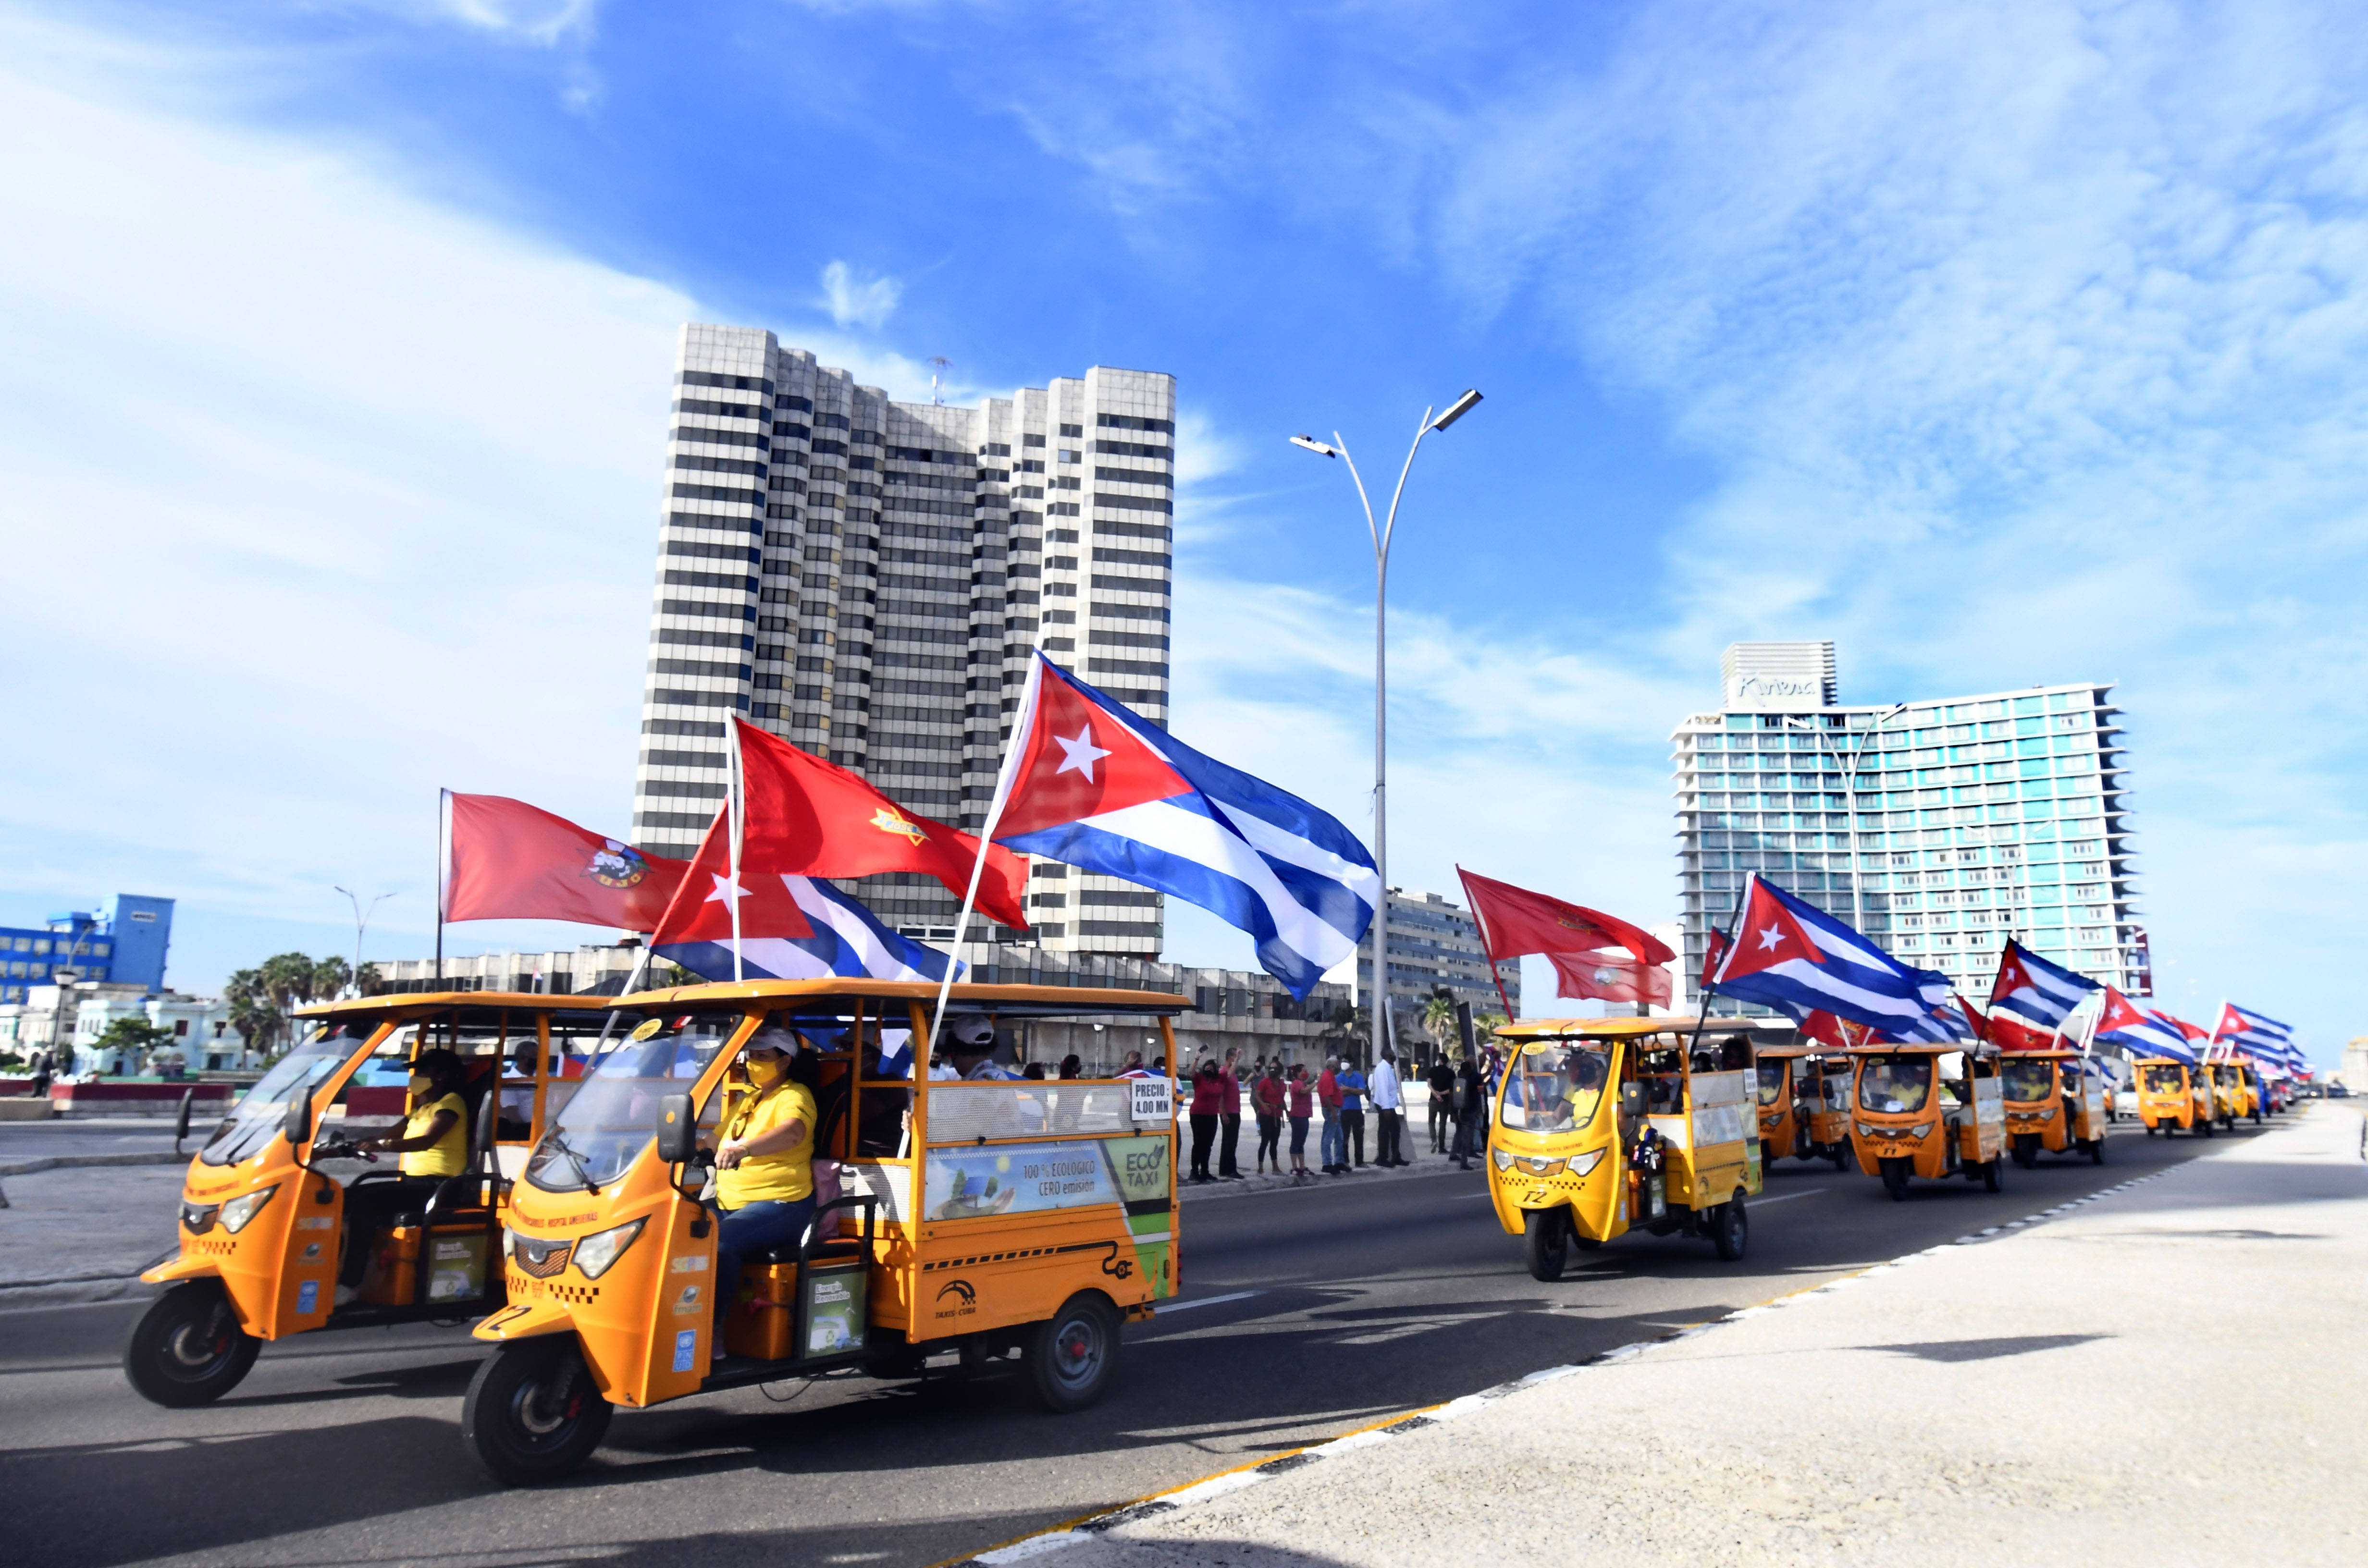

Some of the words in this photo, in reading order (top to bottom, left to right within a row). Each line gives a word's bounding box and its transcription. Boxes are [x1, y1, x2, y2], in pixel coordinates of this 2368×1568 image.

[1135, 1084, 1165, 1097] PRECIO
[1135, 1101, 1154, 1114] 4.00
[1156, 1101, 1169, 1113] MN
[1127, 1152, 1160, 1171] ECO
[1024, 1164, 1038, 1179] 100
[1041, 1164, 1049, 1177] %
[1127, 1172, 1158, 1187] TAXI
[1039, 1181, 1060, 1196] CERO
